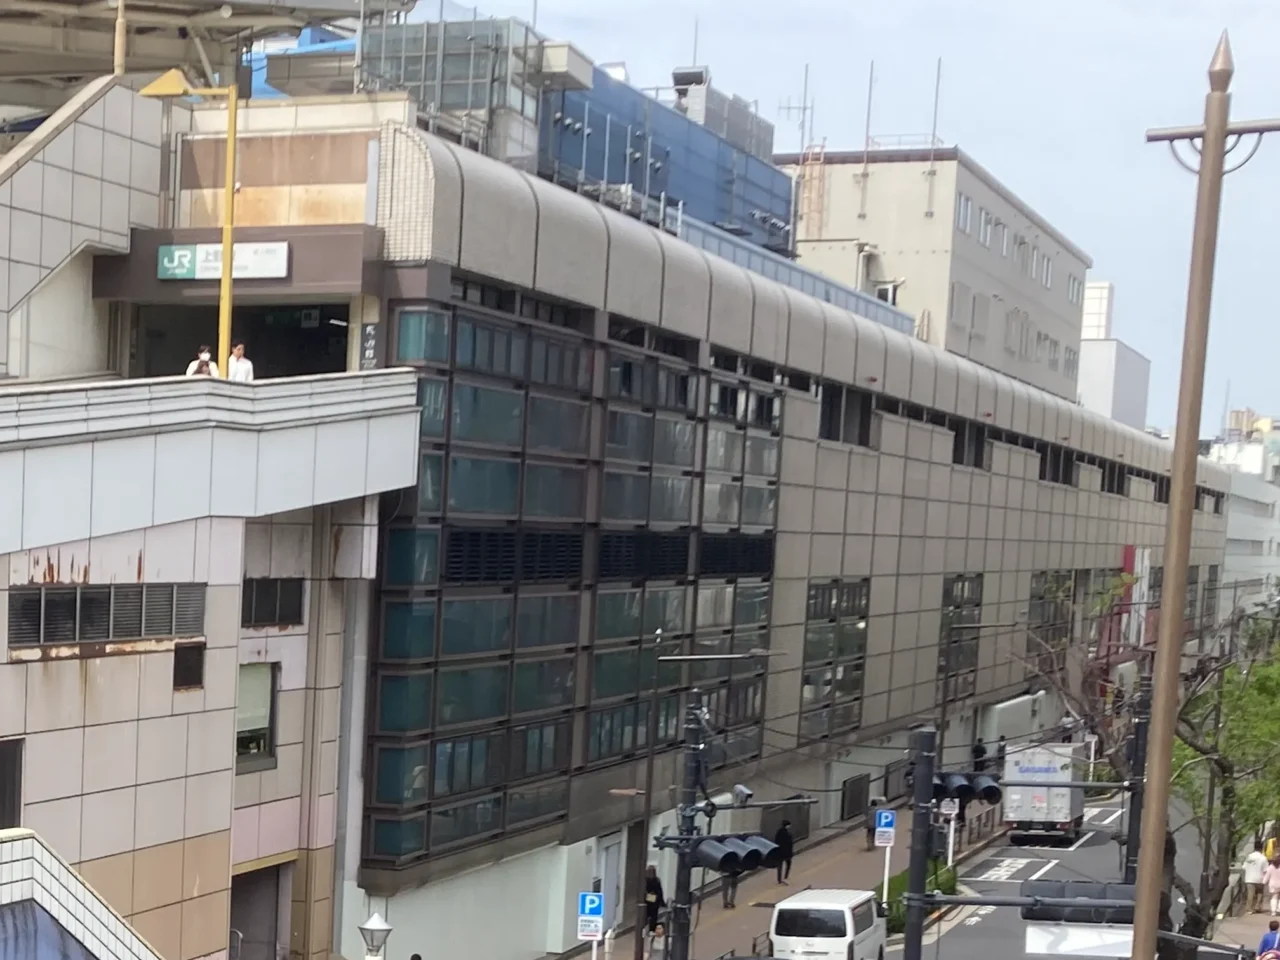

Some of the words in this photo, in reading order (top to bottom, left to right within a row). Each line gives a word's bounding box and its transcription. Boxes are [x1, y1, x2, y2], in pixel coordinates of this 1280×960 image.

[163, 249, 192, 268] JR
[880, 812, 893, 827] P
[584, 895, 600, 914] P
